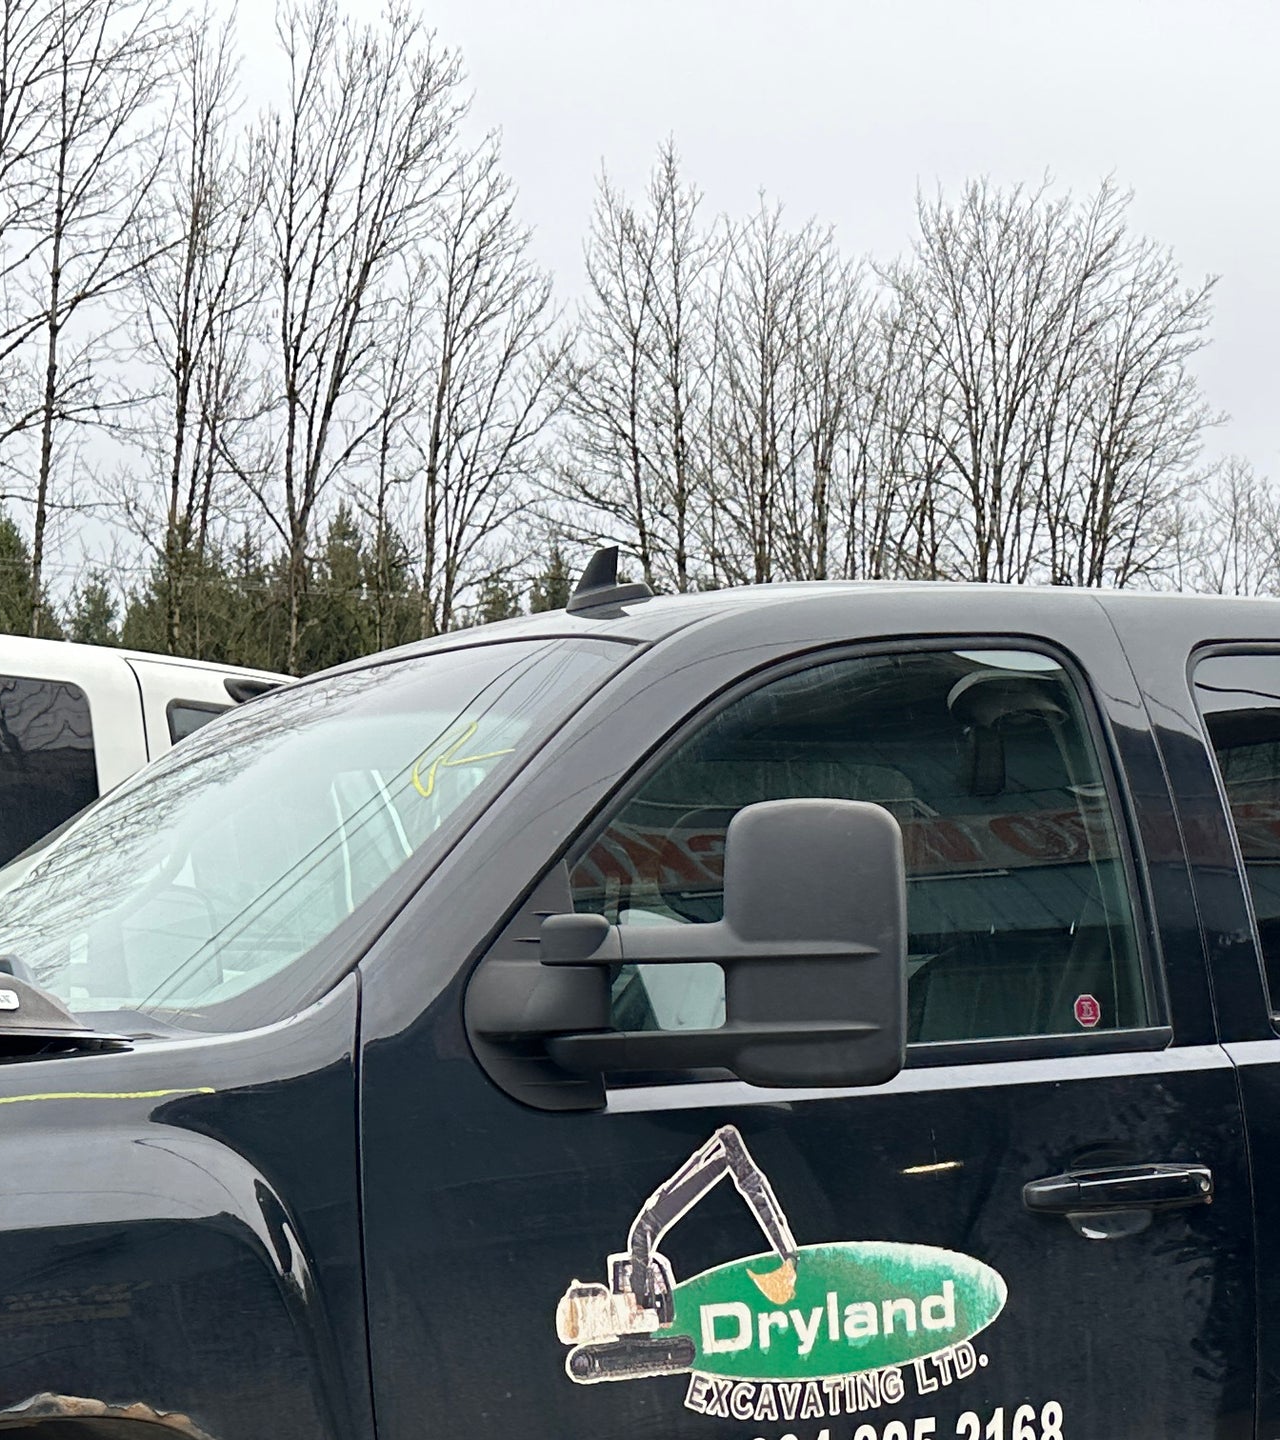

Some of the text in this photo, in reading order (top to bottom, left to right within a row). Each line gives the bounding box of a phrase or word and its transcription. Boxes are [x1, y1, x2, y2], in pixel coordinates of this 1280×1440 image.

[699, 1280, 956, 1355] Dryland
[684, 1340, 989, 1421] EXCAVATING LTD.
